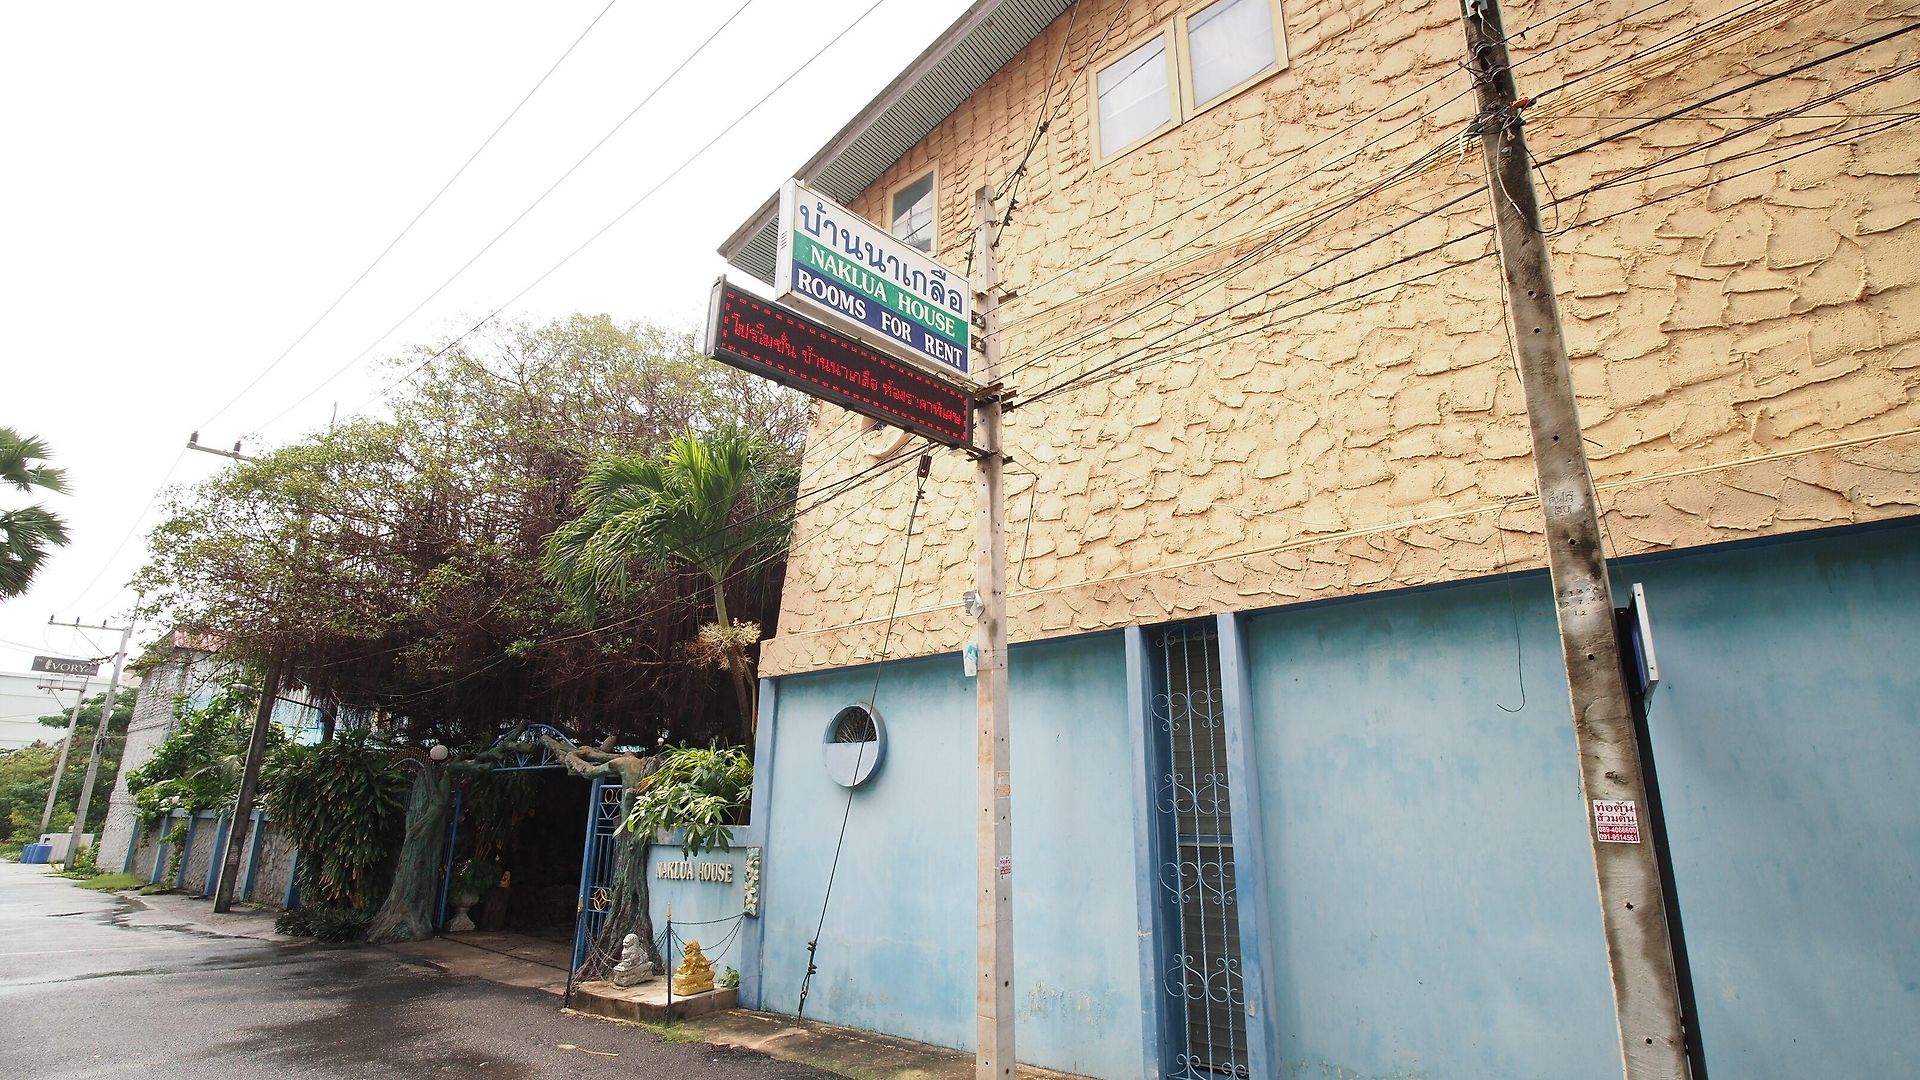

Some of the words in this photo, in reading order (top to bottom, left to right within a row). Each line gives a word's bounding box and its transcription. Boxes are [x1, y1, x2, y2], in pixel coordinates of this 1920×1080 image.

[800, 202, 963, 315] บ้านนาเกลือ
[811, 244, 888, 303] NAKLUA
[898, 291, 955, 337] HOUSE
[798, 268, 867, 320] ROOMS
[881, 311, 912, 342] FOR
[924, 333, 963, 367] RENT
[656, 861, 695, 880] NAKLUA
